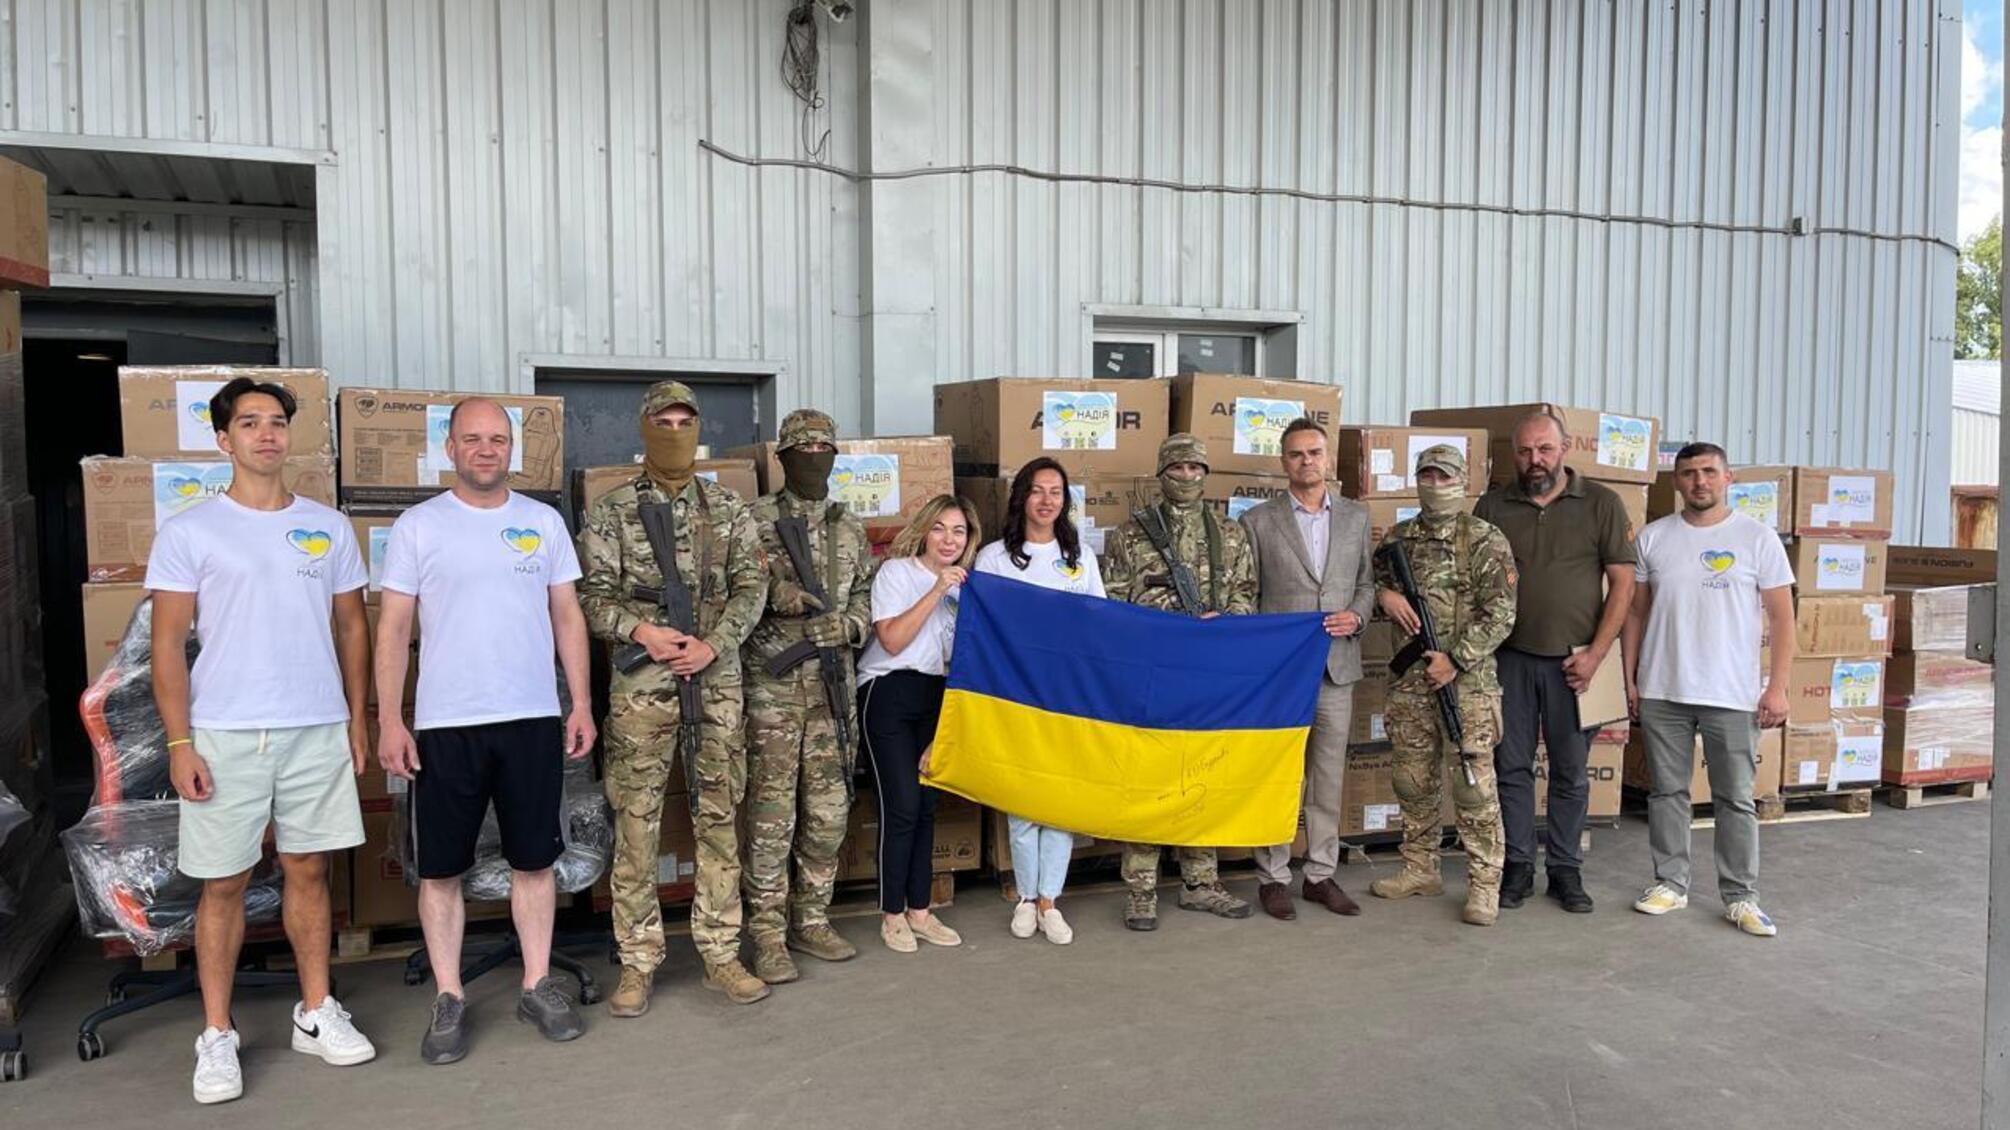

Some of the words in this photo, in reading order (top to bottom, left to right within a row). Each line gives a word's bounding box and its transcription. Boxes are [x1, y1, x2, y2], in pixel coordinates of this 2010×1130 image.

[383, 402, 426, 412] ARMO
[1077, 410, 1110, 420] НАДІЯ
[855, 473, 890, 483] НАДІЯ
